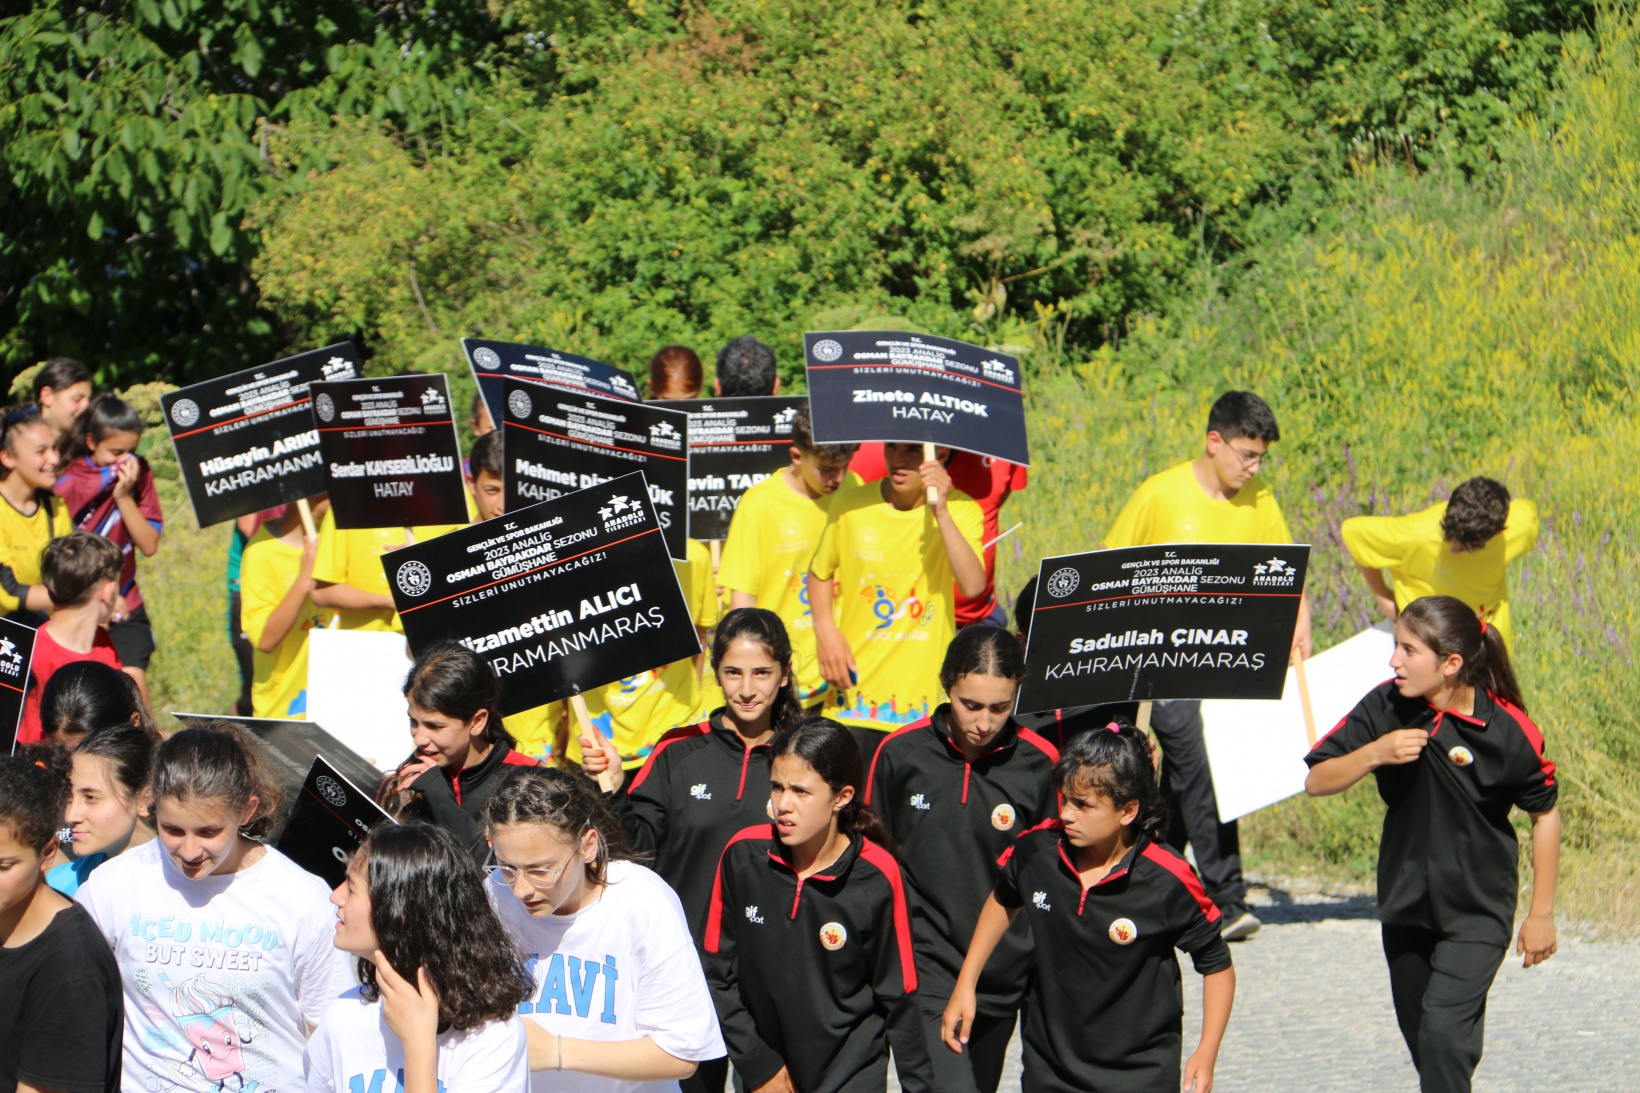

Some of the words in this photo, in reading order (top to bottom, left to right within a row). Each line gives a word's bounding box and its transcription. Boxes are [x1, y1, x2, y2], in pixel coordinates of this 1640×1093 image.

[852, 389, 915, 403] Zinete
[919, 392, 988, 418] ALTIOK
[892, 406, 954, 424] HATAY
[613, 430, 647, 444] SEZONU
[734, 425, 771, 434] SEZONU
[538, 433, 570, 447] SİZLERİ
[200, 446, 271, 477] Hüseyin
[330, 461, 365, 478] Serdar
[365, 453, 454, 476] KAYSERİLİOĞLU
[516, 458, 578, 487] Mehmet
[374, 481, 414, 498] HATAY
[504, 522, 518, 531] T.C.
[604, 510, 644, 528] ANADOLU
[467, 538, 496, 553] GENÇLİK
[495, 536, 506, 544] VE
[505, 530, 525, 541] SPOR
[524, 516, 563, 535] BAKANLIĞI
[446, 564, 486, 583] OSMAN
[486, 542, 553, 571] BAYRAKDAR
[554, 527, 598, 548] SEZONU
[484, 545, 510, 561] 2023
[512, 532, 552, 552] ANALİG
[492, 552, 558, 580] GÜMÜŞHANE
[1121, 560, 1151, 569] GENÇLİK
[1133, 568, 1159, 578] 2023
[1161, 566, 1203, 575] ANALİG
[452, 586, 499, 608] SİZLERİ
[501, 551, 607, 592] UNUTMAYACAĞIZ!
[1091, 579, 1130, 592] OSMAN
[1131, 575, 1198, 586] BAYRAKDAR
[1200, 576, 1246, 584] SEZONU
[1132, 584, 1198, 594] GÜMÜŞHANE
[1086, 598, 1130, 612] SİZLERİ
[1134, 596, 1243, 606] UNUTMAYACAĞIZ!
[458, 608, 574, 654] izamettin
[580, 582, 642, 620] ALICI
[488, 606, 664, 677] RAMANMARAŞ
[1068, 628, 1164, 654] Sadullah
[1170, 628, 1248, 649] ÇINAR
[1045, 652, 1266, 681] KAHRAMANMARAŞ
[690, 784, 706, 796] gif
[910, 794, 924, 806] gif
[1033, 891, 1047, 903] gif
[745, 906, 758, 918] gif
[130, 912, 192, 943] ICED
[200, 919, 279, 951] MOOD
[146, 942, 186, 966] BUT
[190, 946, 263, 972] SWEET
